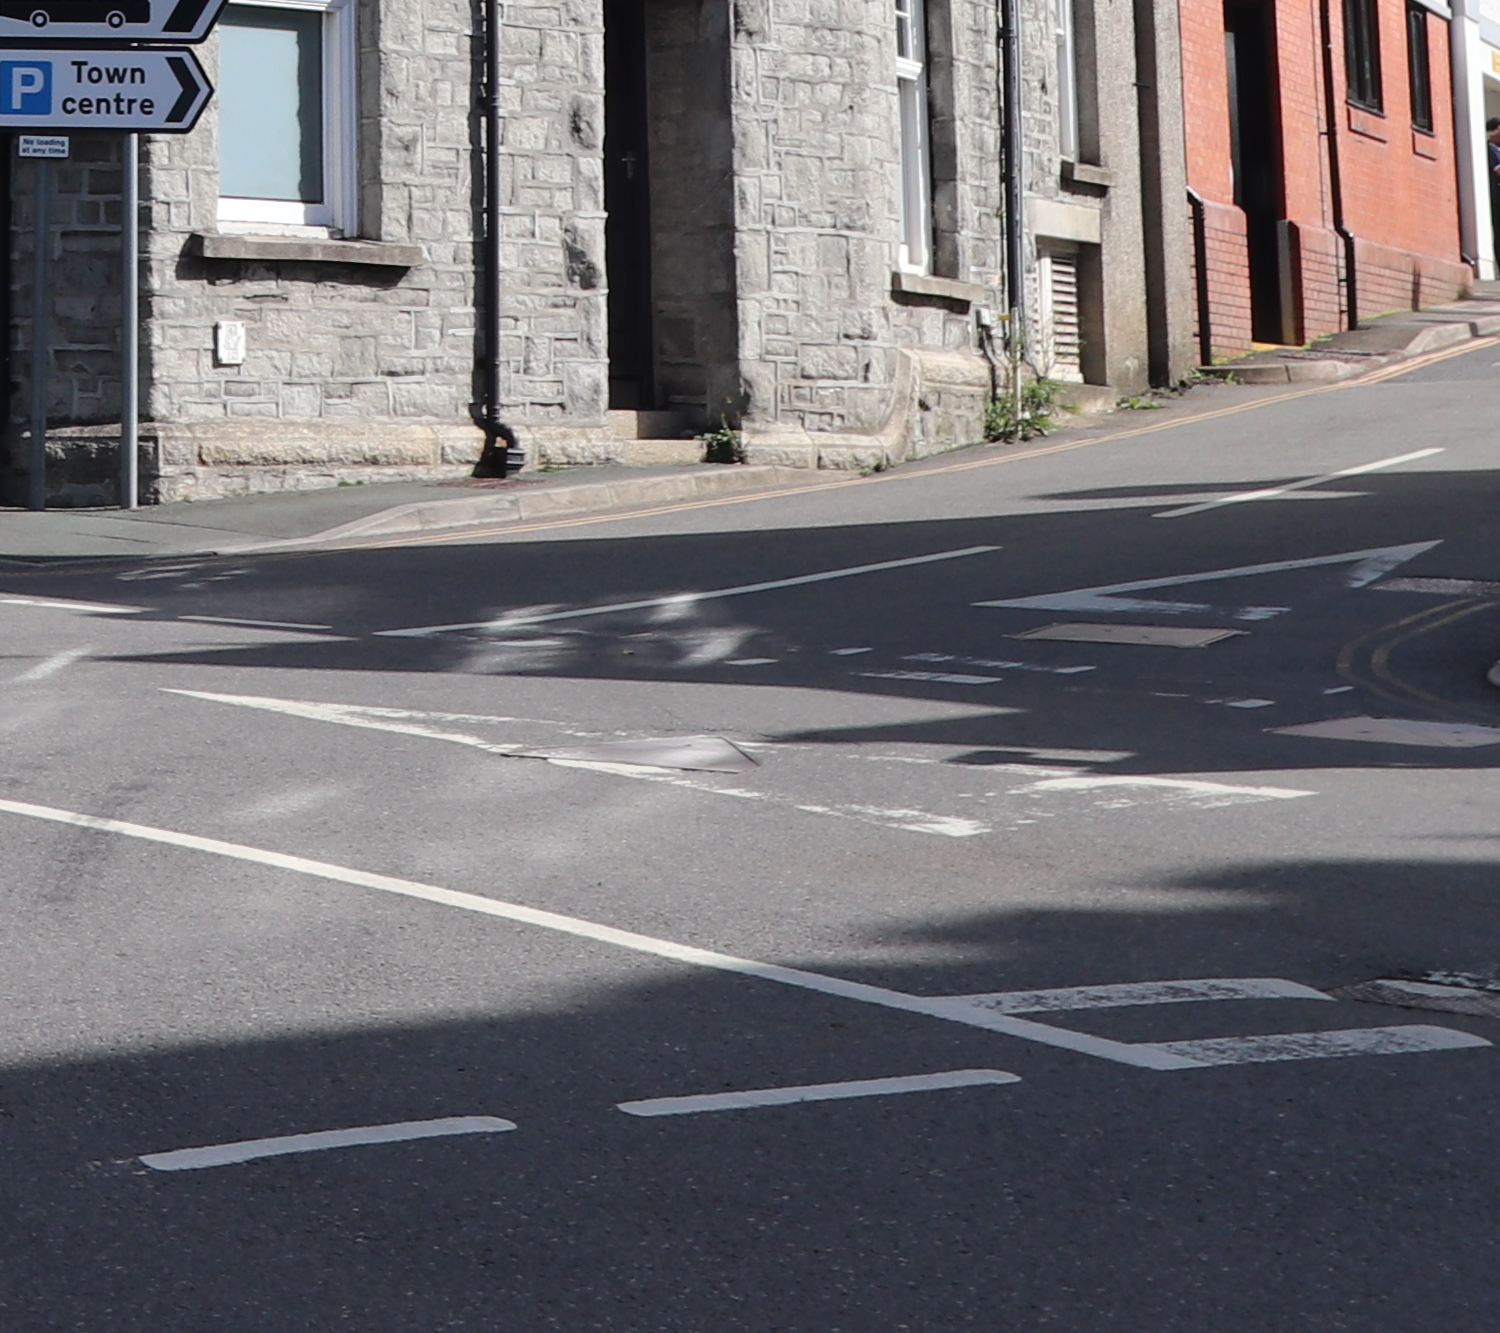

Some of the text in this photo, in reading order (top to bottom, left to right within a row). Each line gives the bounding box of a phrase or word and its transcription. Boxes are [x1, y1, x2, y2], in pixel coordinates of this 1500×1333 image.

[70, 61, 146, 84] Town
[11, 67, 44, 110] P
[61, 93, 155, 115] centre
[36, 138, 66, 147] loading
